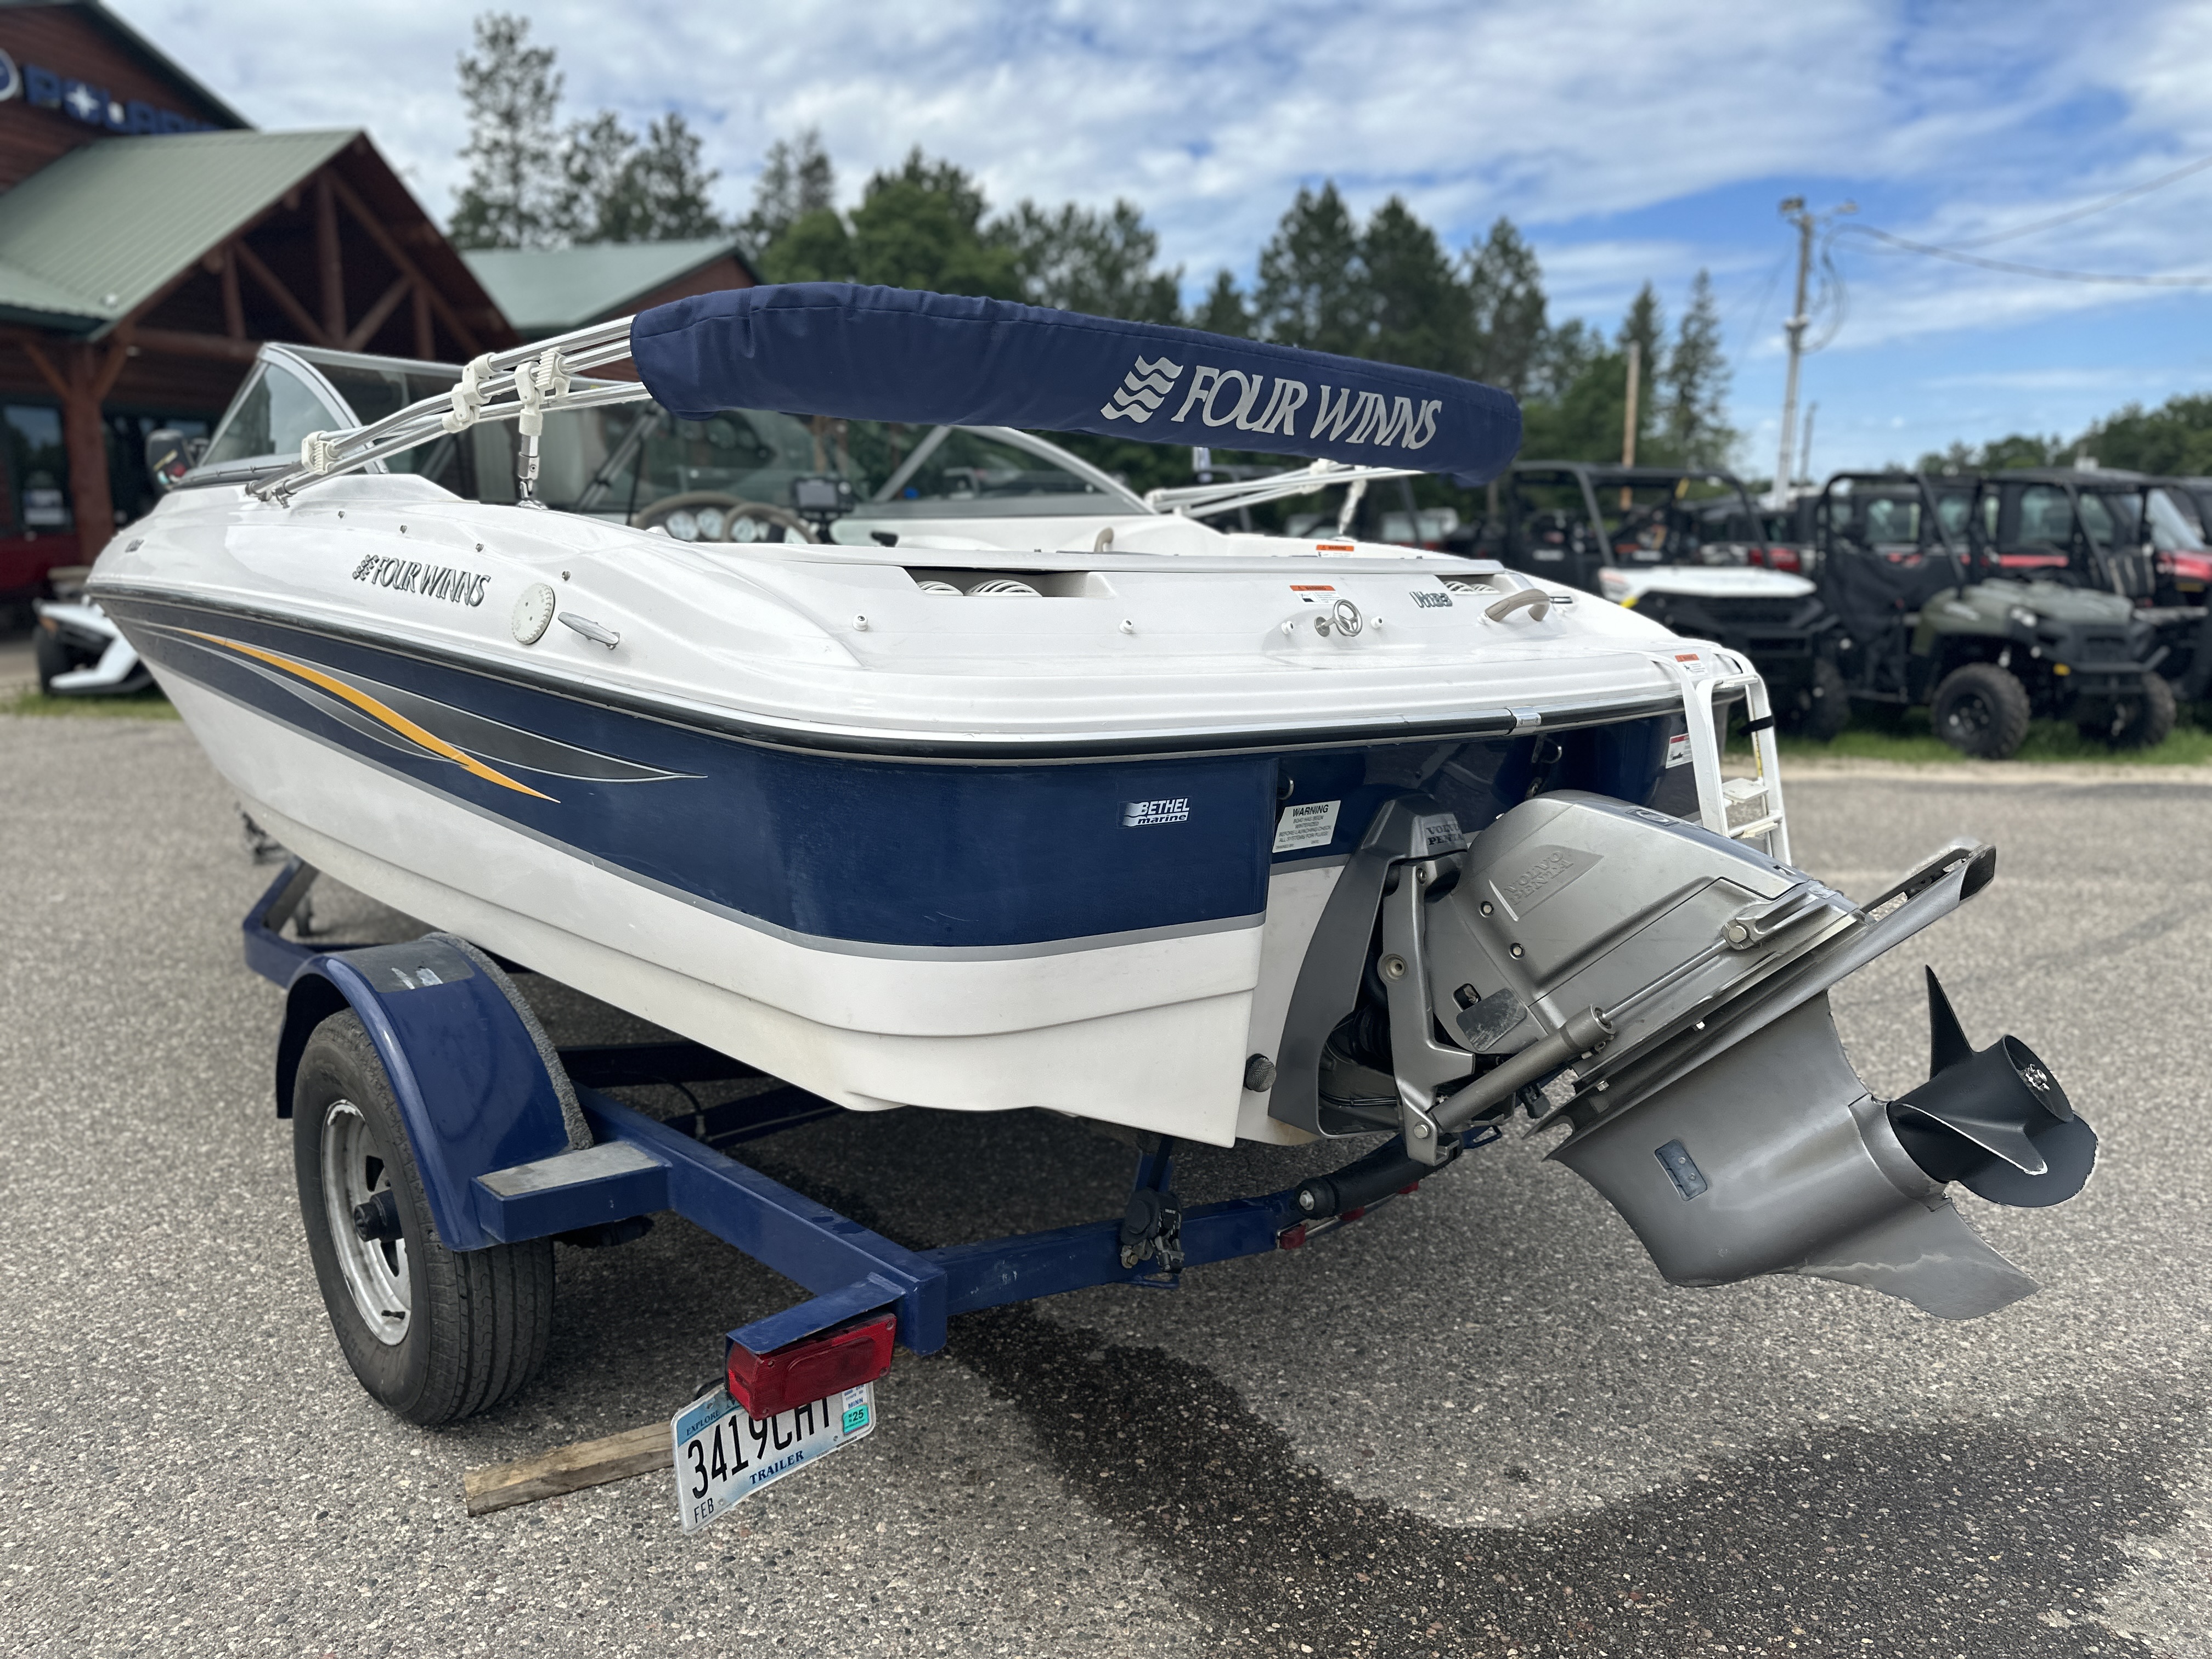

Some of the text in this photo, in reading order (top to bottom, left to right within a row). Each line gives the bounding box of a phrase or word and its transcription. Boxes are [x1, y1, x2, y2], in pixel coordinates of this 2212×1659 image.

[1171, 365, 1442, 450] FOUR WINNS
[371, 556, 492, 607] FOUR WINNS
[1137, 814, 1187, 825] marine
[1141, 798, 1190, 815] BETHEL
[1293, 804, 1329, 817] WARNING
[1504, 850, 1563, 893] VOLVO
[1509, 860, 1574, 905] PENTA
[848, 1397, 863, 1409] MINN
[852, 1408, 864, 1422] 25
[686, 1409, 721, 1436] EXPLORE
[749, 1450, 804, 1485] TRAILER
[694, 1497, 714, 1523] FEB
